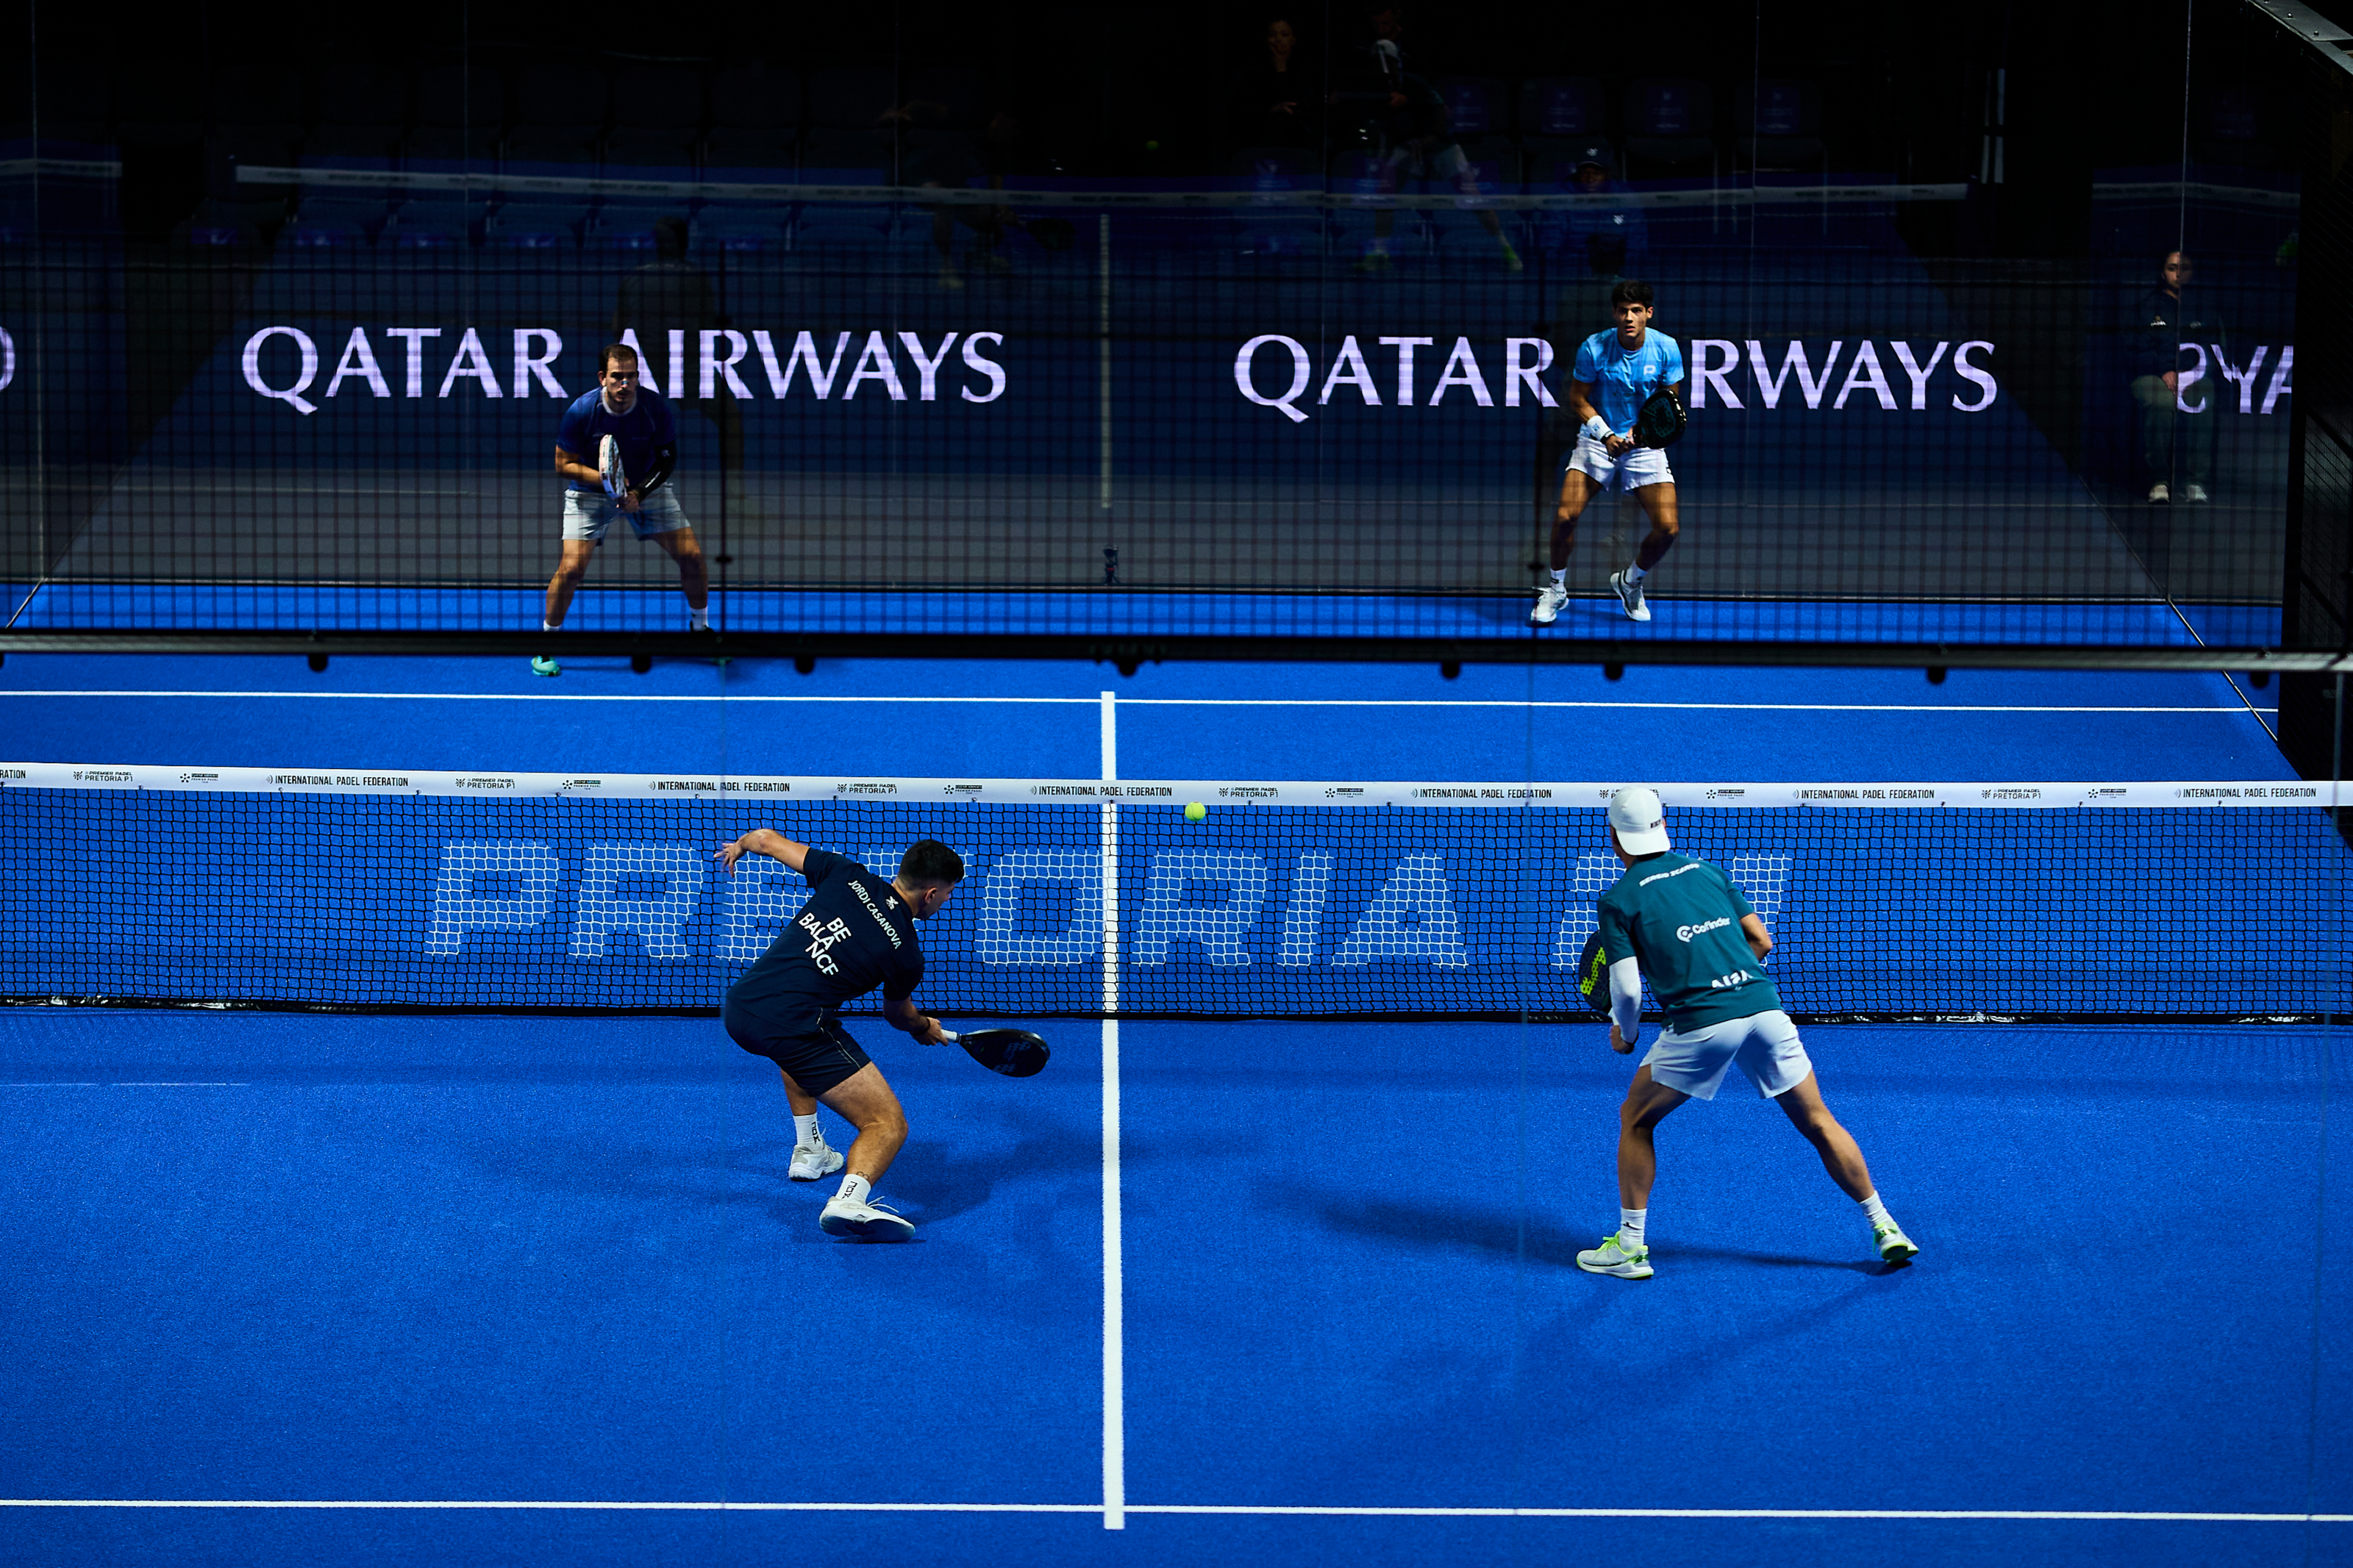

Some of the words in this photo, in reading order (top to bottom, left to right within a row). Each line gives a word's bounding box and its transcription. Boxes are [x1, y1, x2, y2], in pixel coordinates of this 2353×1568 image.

[242, 326, 568, 415] QATAR
[1234, 334, 1560, 423] QATAR
[1690, 339, 1998, 412] RWAYS
[275, 776, 333, 785] INTERNATIONAL
[336, 776, 360, 786] PADEL
[363, 777, 408, 787] FEDERATION
[657, 781, 717, 791] INTERNATIONAL
[744, 783, 790, 792] FEDERATION
[1039, 786, 1097, 796] INTERNATIONAL
[1099, 787, 1124, 796] PADEL
[1126, 787, 1172, 797] FEDERATION
[1420, 789, 1478, 798] INTERNATIONAL
[1481, 789, 1504, 798] PADEL
[1507, 789, 1552, 798] FEDEATION
[1802, 790, 1859, 799] INTERNATIONAL
[1863, 790, 1886, 799] PADEL
[1889, 790, 1935, 799] FEDERATION
[2183, 788, 2241, 798] INTERNATIONAL
[2244, 788, 2268, 798] PADEL
[2271, 788, 2316, 798] FEDERATION
[848, 880, 871, 904] JORDI
[866, 903, 901, 950] CASANOVA
[798, 912, 835, 951] BALA
[826, 917, 851, 942] BE
[1692, 917, 1731, 934] Cofinder
[805, 941, 839, 975] NCE
